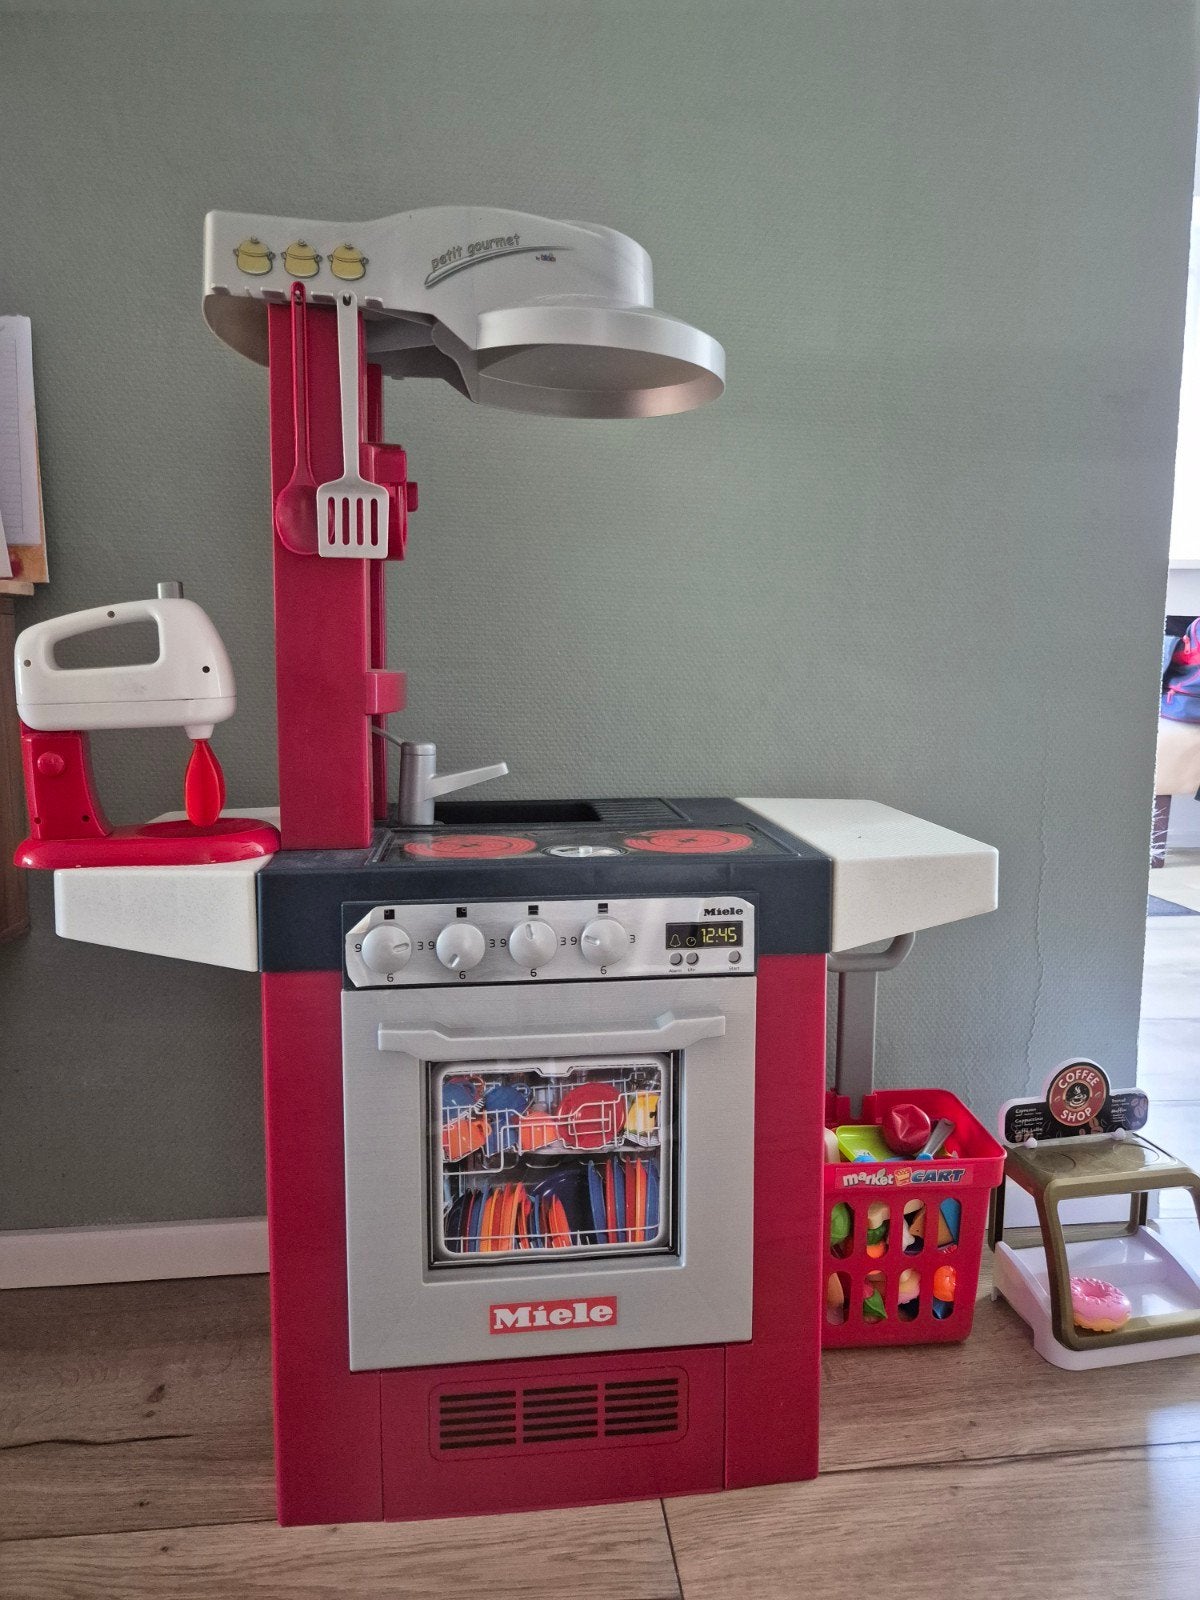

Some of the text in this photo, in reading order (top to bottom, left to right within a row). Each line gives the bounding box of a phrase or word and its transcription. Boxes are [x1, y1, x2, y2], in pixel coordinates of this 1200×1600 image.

[431, 233, 520, 272] petit gourmet
[703, 907, 744, 917] Miele
[629, 934, 636, 943] 3
[701, 927, 737, 943] 12:45
[417, 941, 424, 950] 3
[428, 941, 436, 950] 9
[489, 938, 496, 948] 3
[500, 938, 507, 948] 9
[560, 937, 567, 946] 3
[570, 936, 578, 946] 9
[355, 943, 362, 953] 9
[459, 970, 466, 979] 6
[530, 968, 537, 977] 6
[600, 965, 607, 975] 6
[386, 973, 394, 982] 6
[1058, 1069, 1100, 1089] COFFEE
[1060, 1106, 1092, 1122] SHOP
[842, 1168, 965, 1186] market CART
[493, 1302, 613, 1330] Miele
